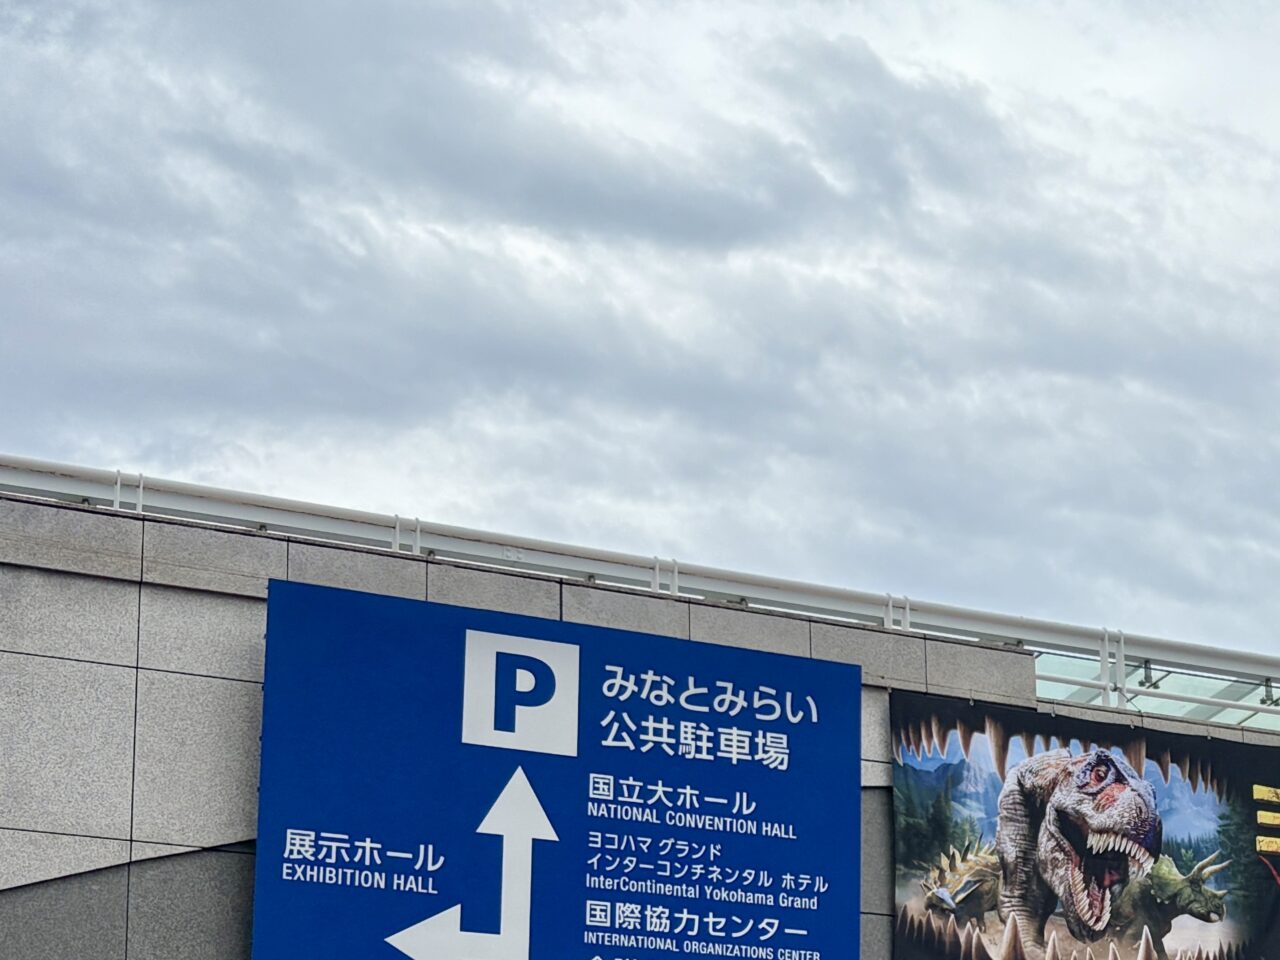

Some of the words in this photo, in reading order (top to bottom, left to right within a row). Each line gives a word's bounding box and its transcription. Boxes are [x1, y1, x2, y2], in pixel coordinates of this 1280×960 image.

[492, 650, 557, 734] P
[603, 666, 817, 722] みなとみらい
[601, 711, 788, 770] 公共駐車場
[590, 774, 756, 814] 国立大ホール
[588, 802, 660, 822] NATIONAL
[666, 811, 756, 834] CONVENTION
[763, 822, 796, 838] HALL
[284, 830, 444, 870] 展示ホール
[589, 832, 651, 852] ヨコハマ
[660, 838, 720, 860] グランド
[283, 864, 385, 888] EXHIBITION
[394, 874, 437, 894] HALL
[587, 874, 698, 898] InterContinental
[705, 886, 774, 905] Yokohama
[780, 893, 816, 909] Grand
[588, 854, 772, 886] インターコンチネンタル
[782, 874, 828, 892] ホテル
[586, 900, 807, 940] 国際協力センター
[584, 932, 678, 951] INTERNATIONAL
[684, 941, 773, 959] ORGANIZATIONS
